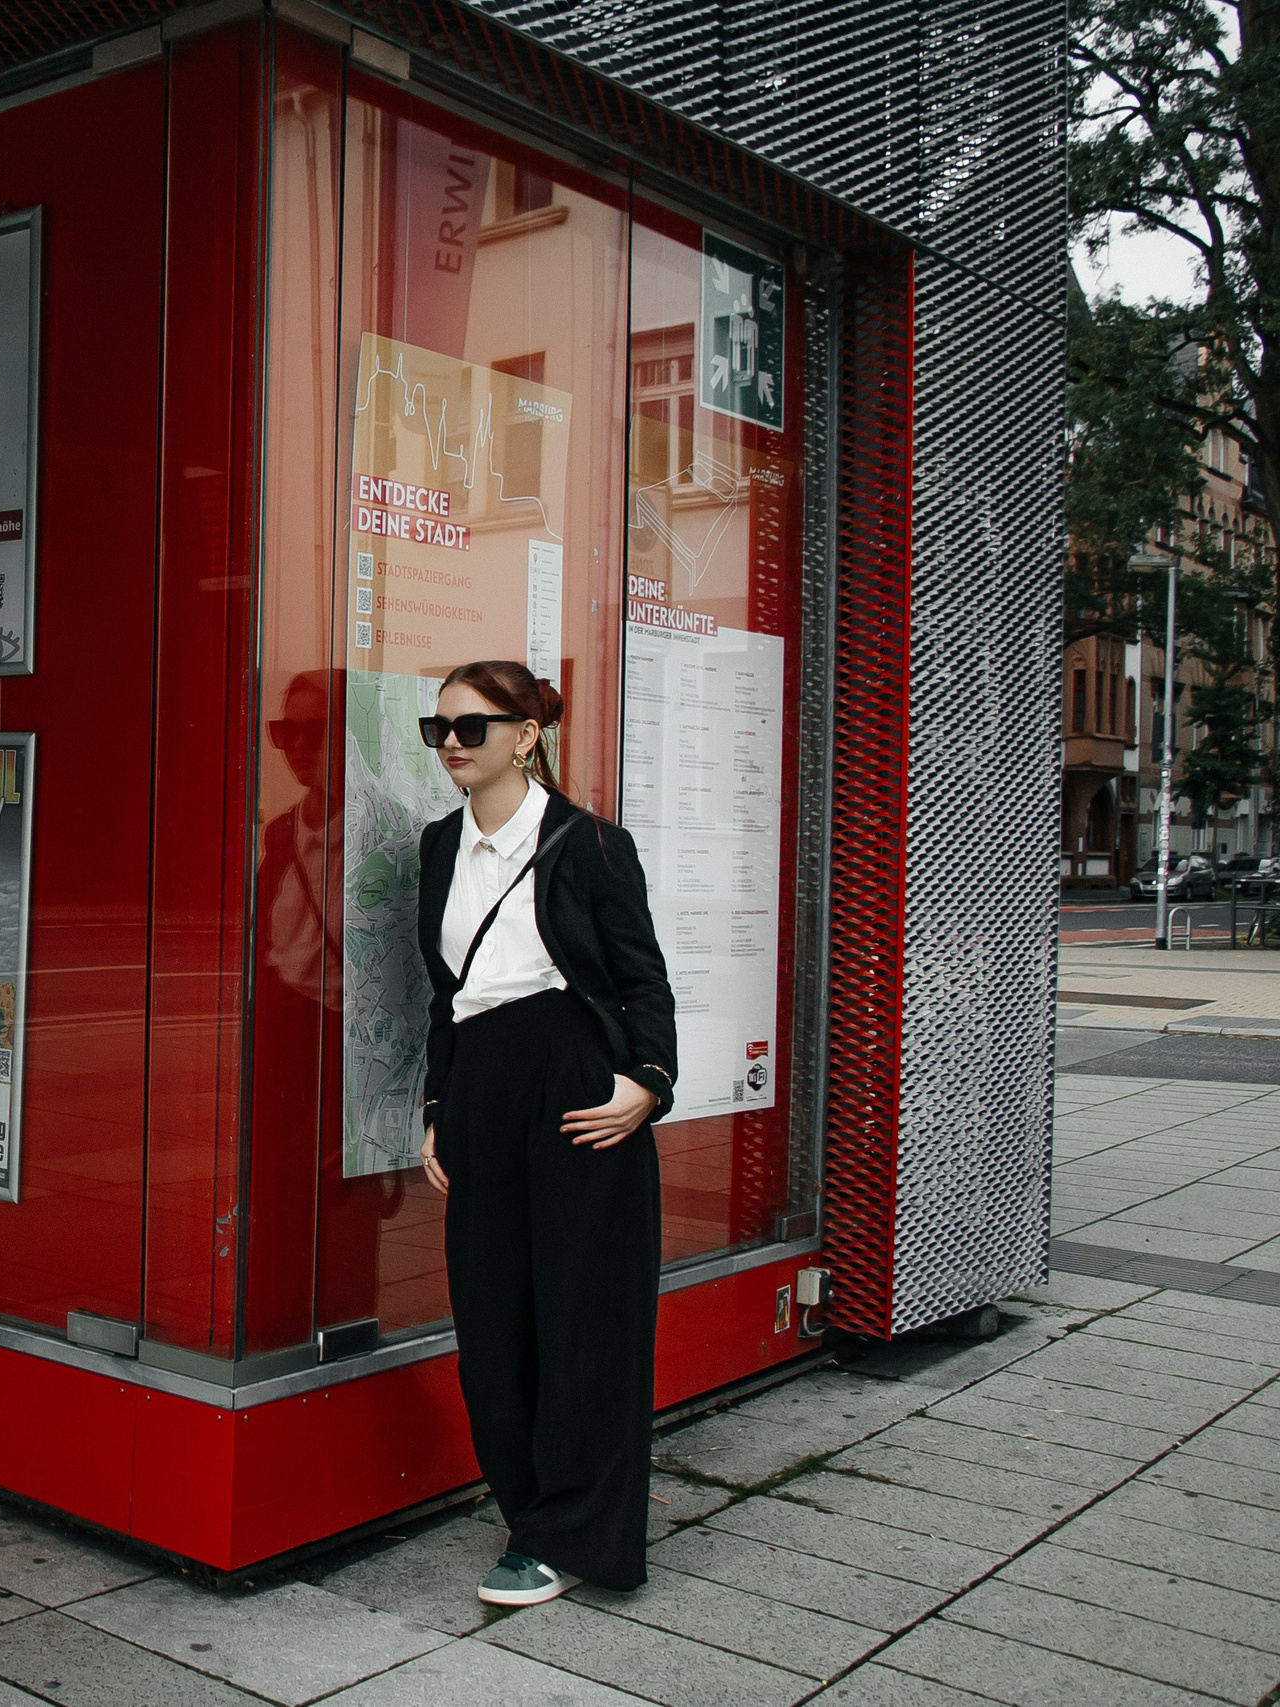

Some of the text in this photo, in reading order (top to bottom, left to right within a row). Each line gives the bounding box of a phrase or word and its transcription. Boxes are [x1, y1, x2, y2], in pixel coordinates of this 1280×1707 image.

[434, 154, 475, 275] ERWI
[358, 475, 450, 517] ENTDECKE
[357, 508, 470, 551] DEINE STADT.
[377, 561, 472, 590] STADTSPAZIERGANG
[628, 575, 666, 602] DEINE
[376, 595, 483, 623] SEHENSWÜRDIGKEITEN
[627, 600, 718, 635] UNTERKÜNFTE.
[375, 629, 432, 650] ERLEBNISSE
[634, 626, 644, 635] DER
[645, 628, 673, 640] MARBURGER
